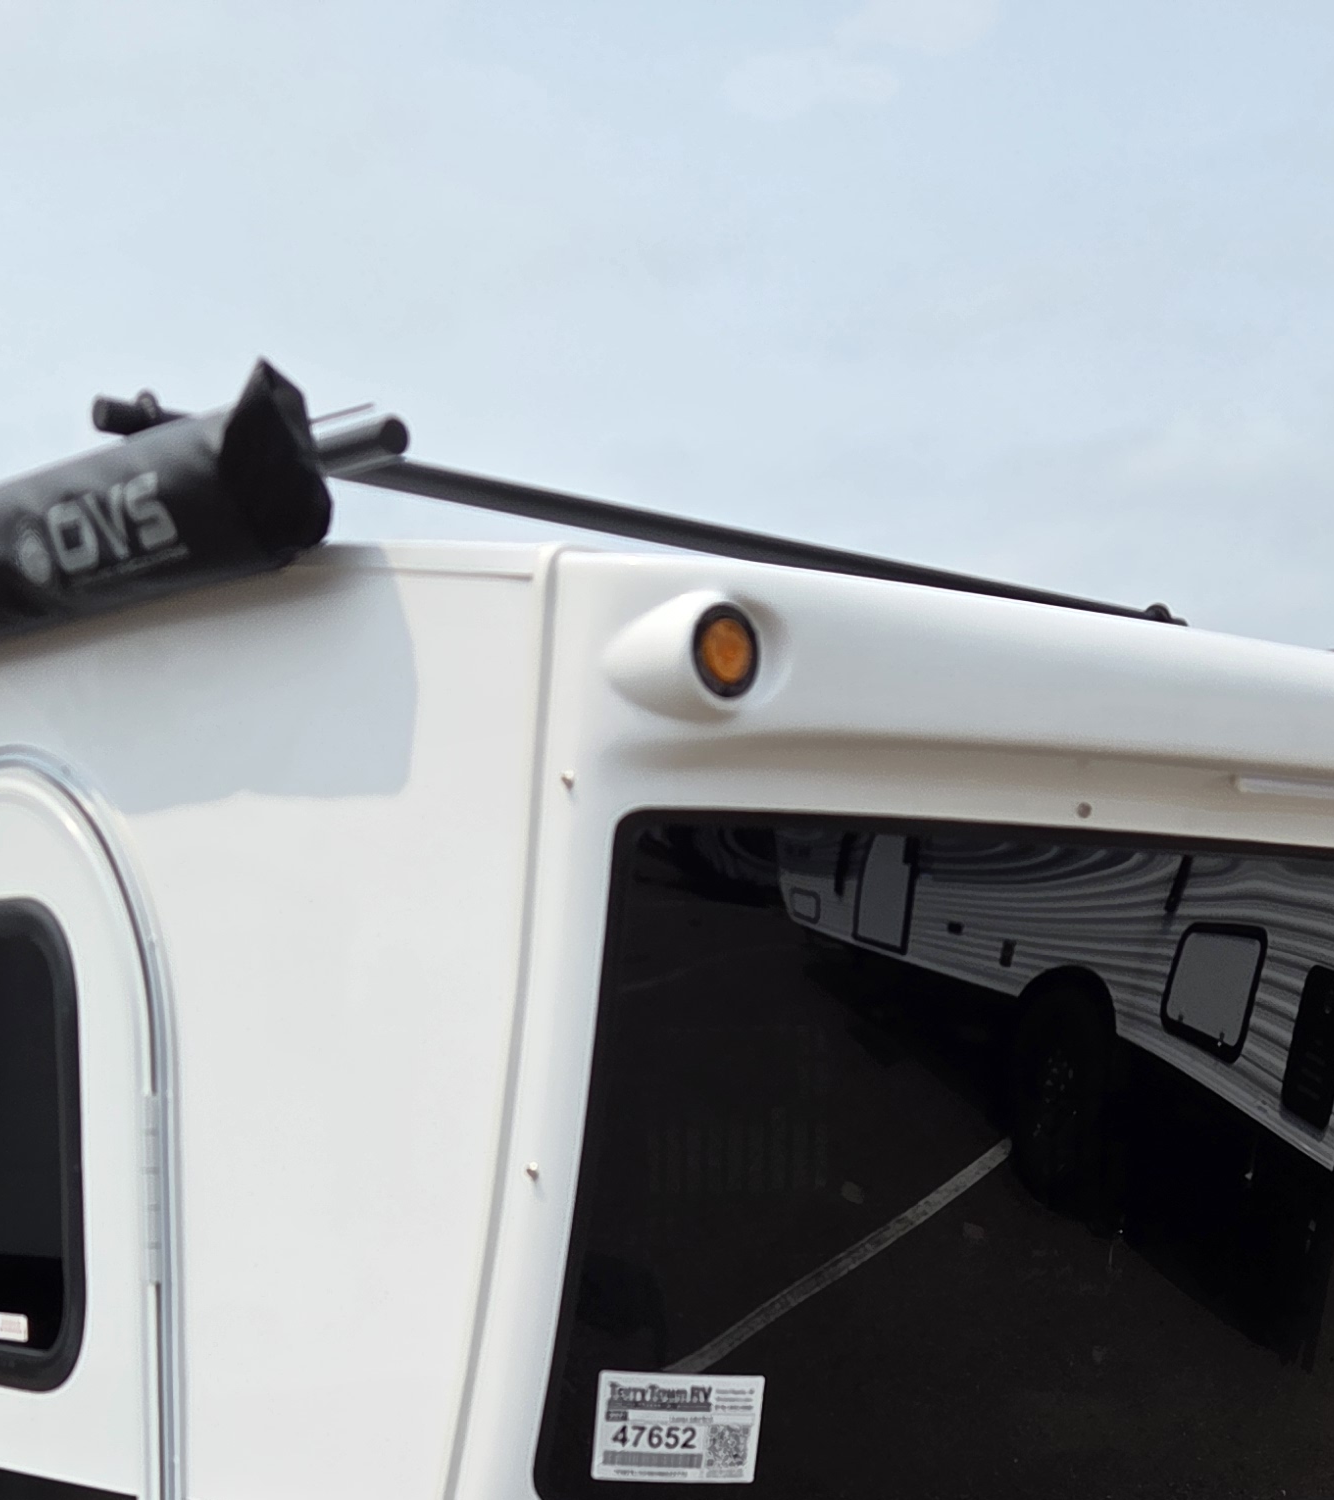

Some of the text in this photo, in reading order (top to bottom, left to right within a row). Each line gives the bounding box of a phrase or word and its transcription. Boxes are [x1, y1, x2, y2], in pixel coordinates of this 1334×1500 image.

[47, 471, 178, 573] OVS
[690, 1386, 712, 1404] RV
[611, 1424, 697, 1449] 47652
